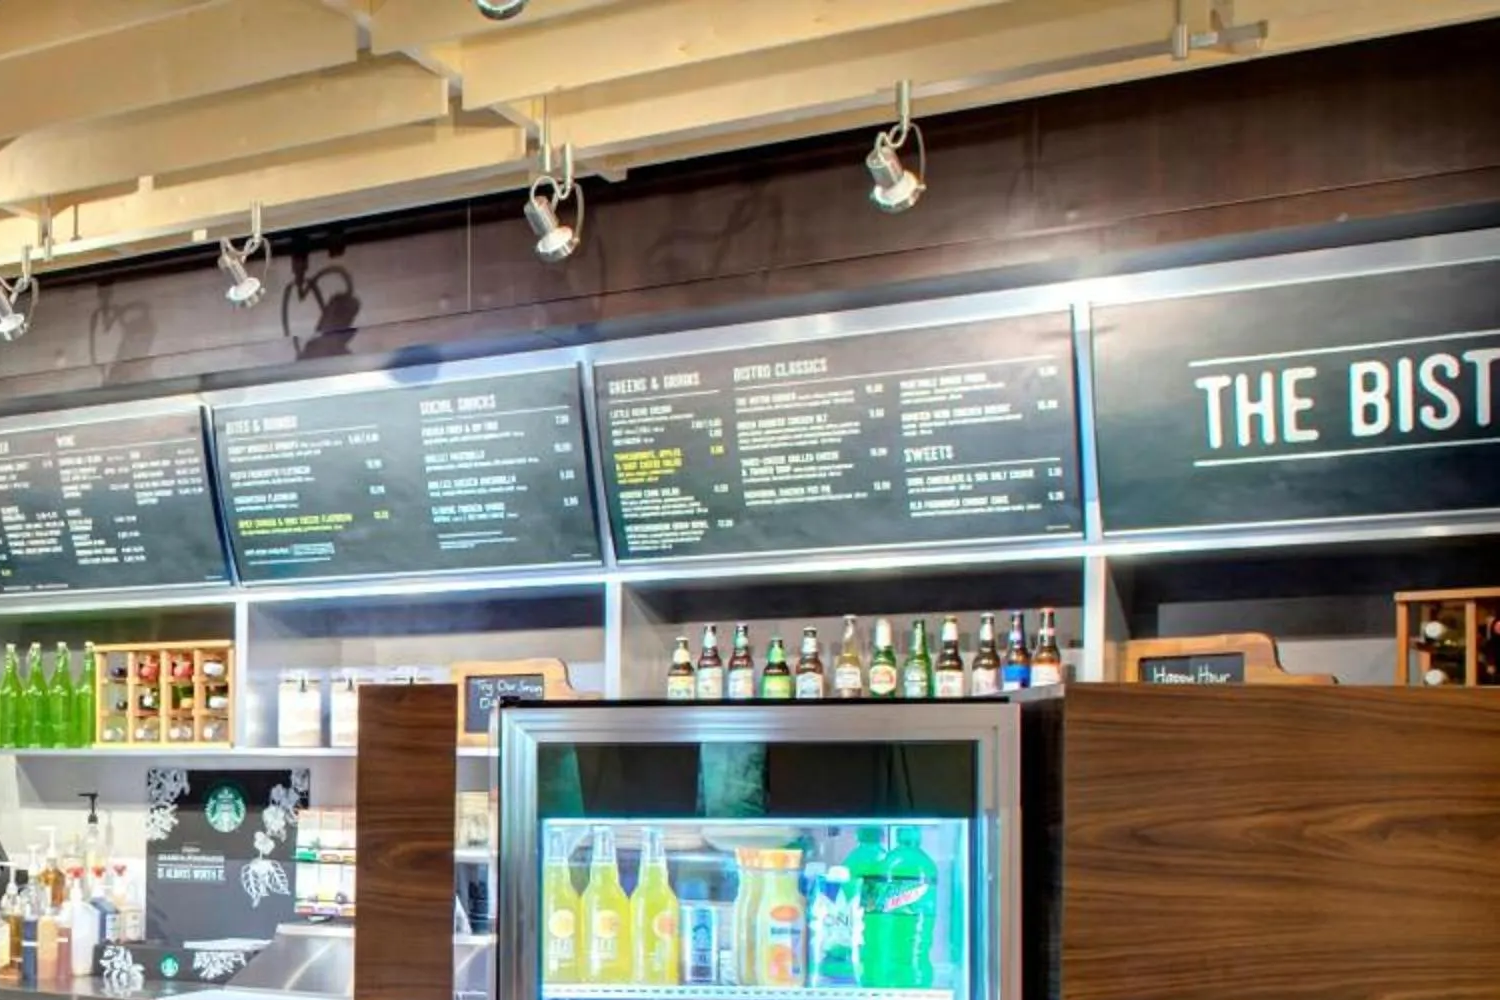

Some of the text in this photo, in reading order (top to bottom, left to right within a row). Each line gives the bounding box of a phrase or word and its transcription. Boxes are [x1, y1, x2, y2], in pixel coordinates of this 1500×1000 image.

[1194, 348, 1500, 449] THE BIST
[903, 444, 953, 463] SWEETS
